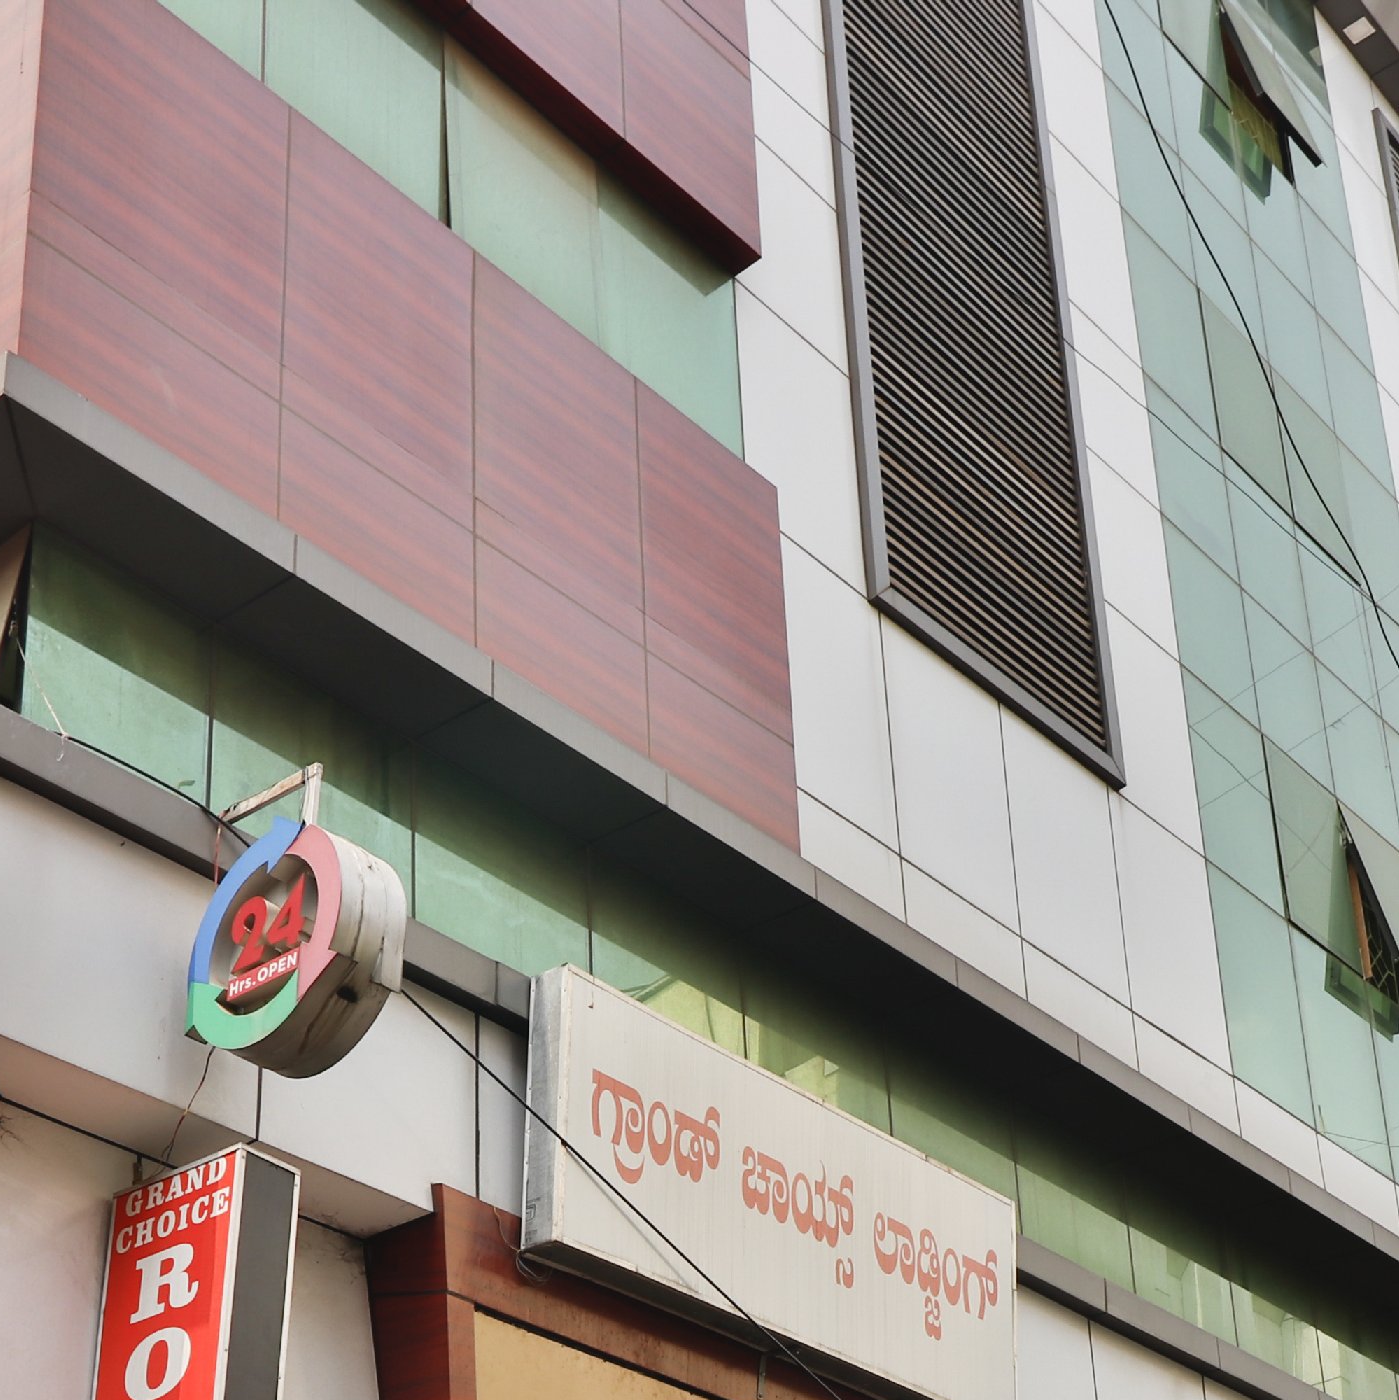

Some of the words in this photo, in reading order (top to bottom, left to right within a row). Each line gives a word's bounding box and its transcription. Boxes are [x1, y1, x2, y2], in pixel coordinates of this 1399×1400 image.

[232, 873, 307, 975] 24
[257, 952, 297, 982] OPEN
[125, 1157, 227, 1217] GRAND
[116, 1186, 230, 1254] CHOICE
